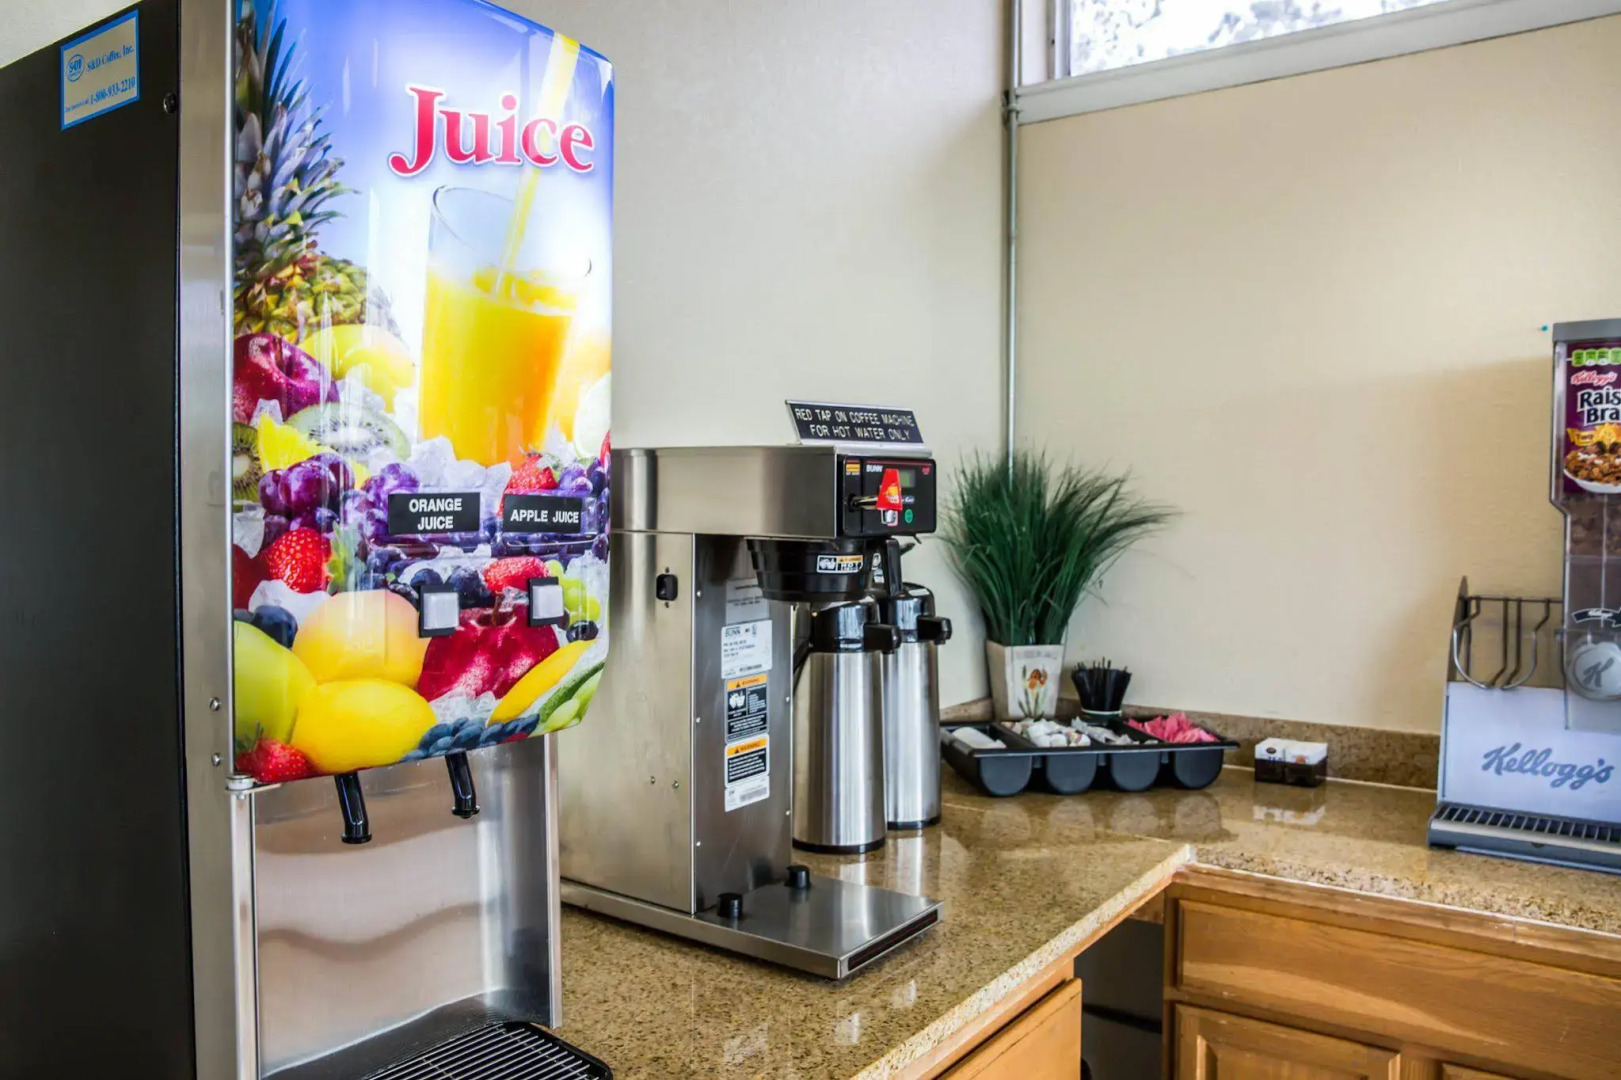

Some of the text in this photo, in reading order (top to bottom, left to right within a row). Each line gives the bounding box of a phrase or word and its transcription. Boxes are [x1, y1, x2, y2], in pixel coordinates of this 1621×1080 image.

[389, 86, 595, 176] Juice
[1580, 387, 1621, 409] Rais
[795, 408, 914, 426] RED TAP ON COFFEE MACHINE
[1586, 407, 1620, 424] Bra
[809, 424, 910, 441] FOR HOT WATER ONLY
[408, 498, 462, 513] ORANGE
[417, 516, 454, 531] JUICE
[510, 509, 579, 524] APPLE JUICE
[1481, 742, 1616, 791] Kellogg's
